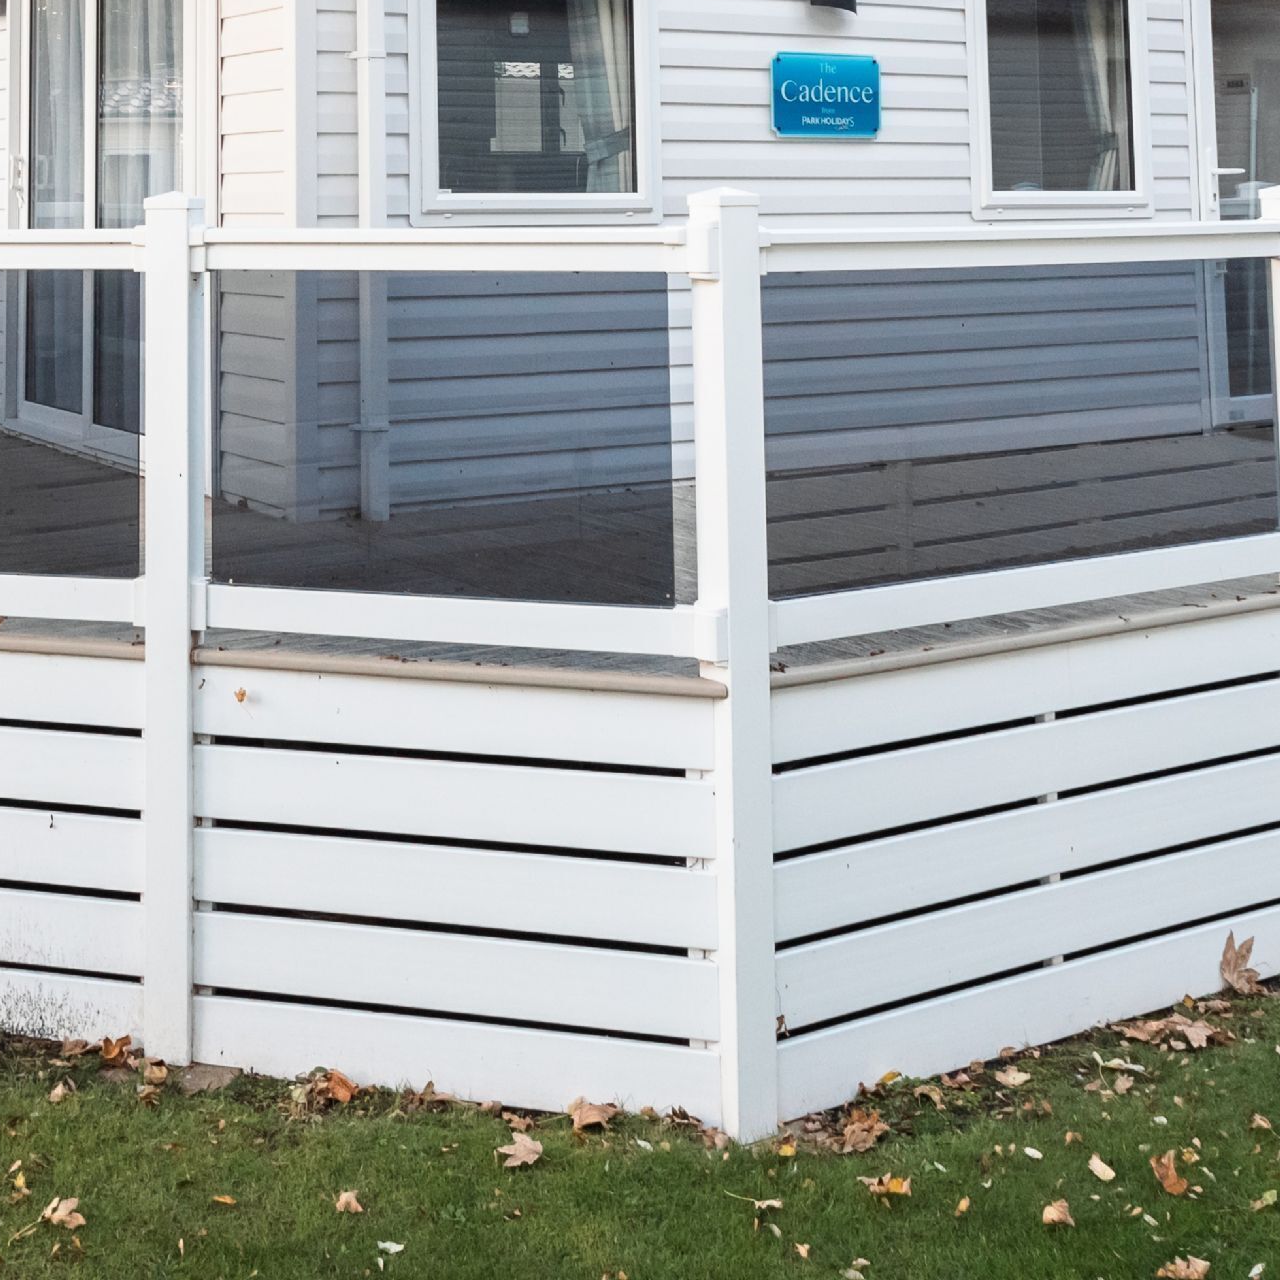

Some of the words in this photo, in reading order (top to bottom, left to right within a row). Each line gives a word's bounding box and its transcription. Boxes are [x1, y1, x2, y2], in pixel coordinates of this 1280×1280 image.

[819, 63, 837, 74] The
[781, 78, 873, 103] Cadence
[802, 116, 819, 126] PARK
[821, 116, 854, 127] HOLIDAYS
